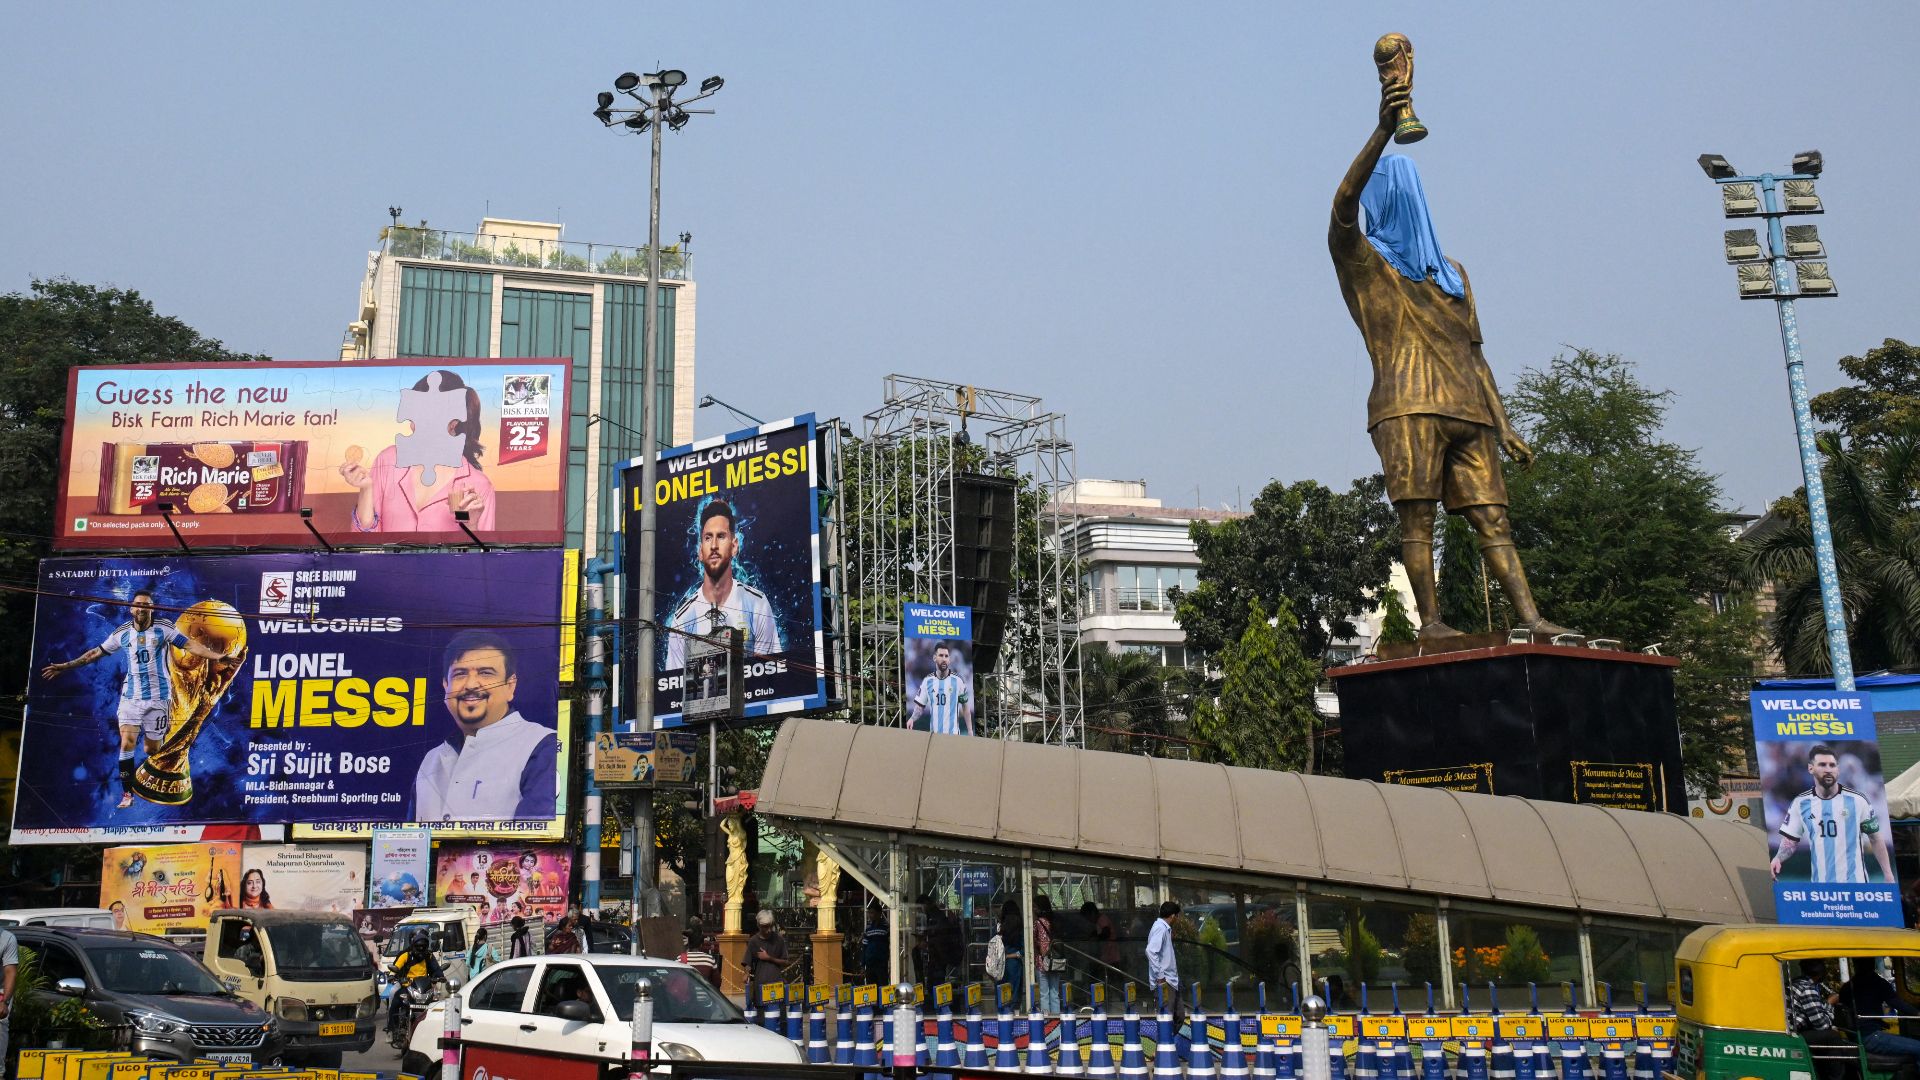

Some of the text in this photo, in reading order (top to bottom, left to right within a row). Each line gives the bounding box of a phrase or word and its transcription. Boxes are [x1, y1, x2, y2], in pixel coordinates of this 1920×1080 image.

[96, 381, 289, 405] Guess the new
[503, 407, 548, 416] BISK FARM
[112, 409, 338, 428] Bisk Farm Rich Marie fan!
[510, 426, 541, 446] 25
[667, 435, 768, 474] WELCOME
[160, 466, 198, 486] Rich
[201, 466, 250, 485] Marie
[633, 445, 807, 511] LONEL MESSI
[135, 485, 153, 497] 25
[103, 521, 130, 529] selected
[131, 521, 150, 530] packs
[55, 570, 97, 579] SATADRU
[98, 569, 129, 578] DUTTA
[296, 570, 357, 583] SREE BHUMI
[295, 586, 346, 598] SPORTING
[294, 603, 320, 614] CLUB
[910, 608, 966, 619] WELCOME
[258, 617, 403, 634] WELCOMES
[918, 625, 960, 636] MESSI
[135, 649, 151, 664] 10
[253, 652, 353, 679] LIONEL
[658, 675, 684, 692] SRI
[755, 687, 775, 698] Club
[250, 677, 427, 728] MESSI
[936, 693, 947, 706] 10
[1761, 699, 1862, 711] WELCOME
[155, 715, 167, 731] 10
[1788, 713, 1839, 721] LIONEL
[1776, 721, 1854, 736] MESSI
[248, 742, 293, 752] Presented
[295, 741, 306, 752] by
[247, 752, 392, 779] Sri Sujit Bose
[1398, 771, 1477, 785] Monumento de Messi
[1582, 769, 1643, 779] Monumento de Messi
[245, 780, 335, 792] MLA-Bidhannagar &
[244, 792, 402, 805] President, Sreebhumi Sporting Club
[1818, 820, 1837, 838] 10
[305, 852, 333, 860] Bhagwat
[477, 854, 488, 864] 13
[1783, 891, 1893, 902] SRI SUJIT BOSE
[1835, 911, 1863, 920] Sporting
[1723, 1044, 1786, 1058] DREAM
[116, 1064, 141, 1072] UCO
[172, 1070, 198, 1078] UCO
